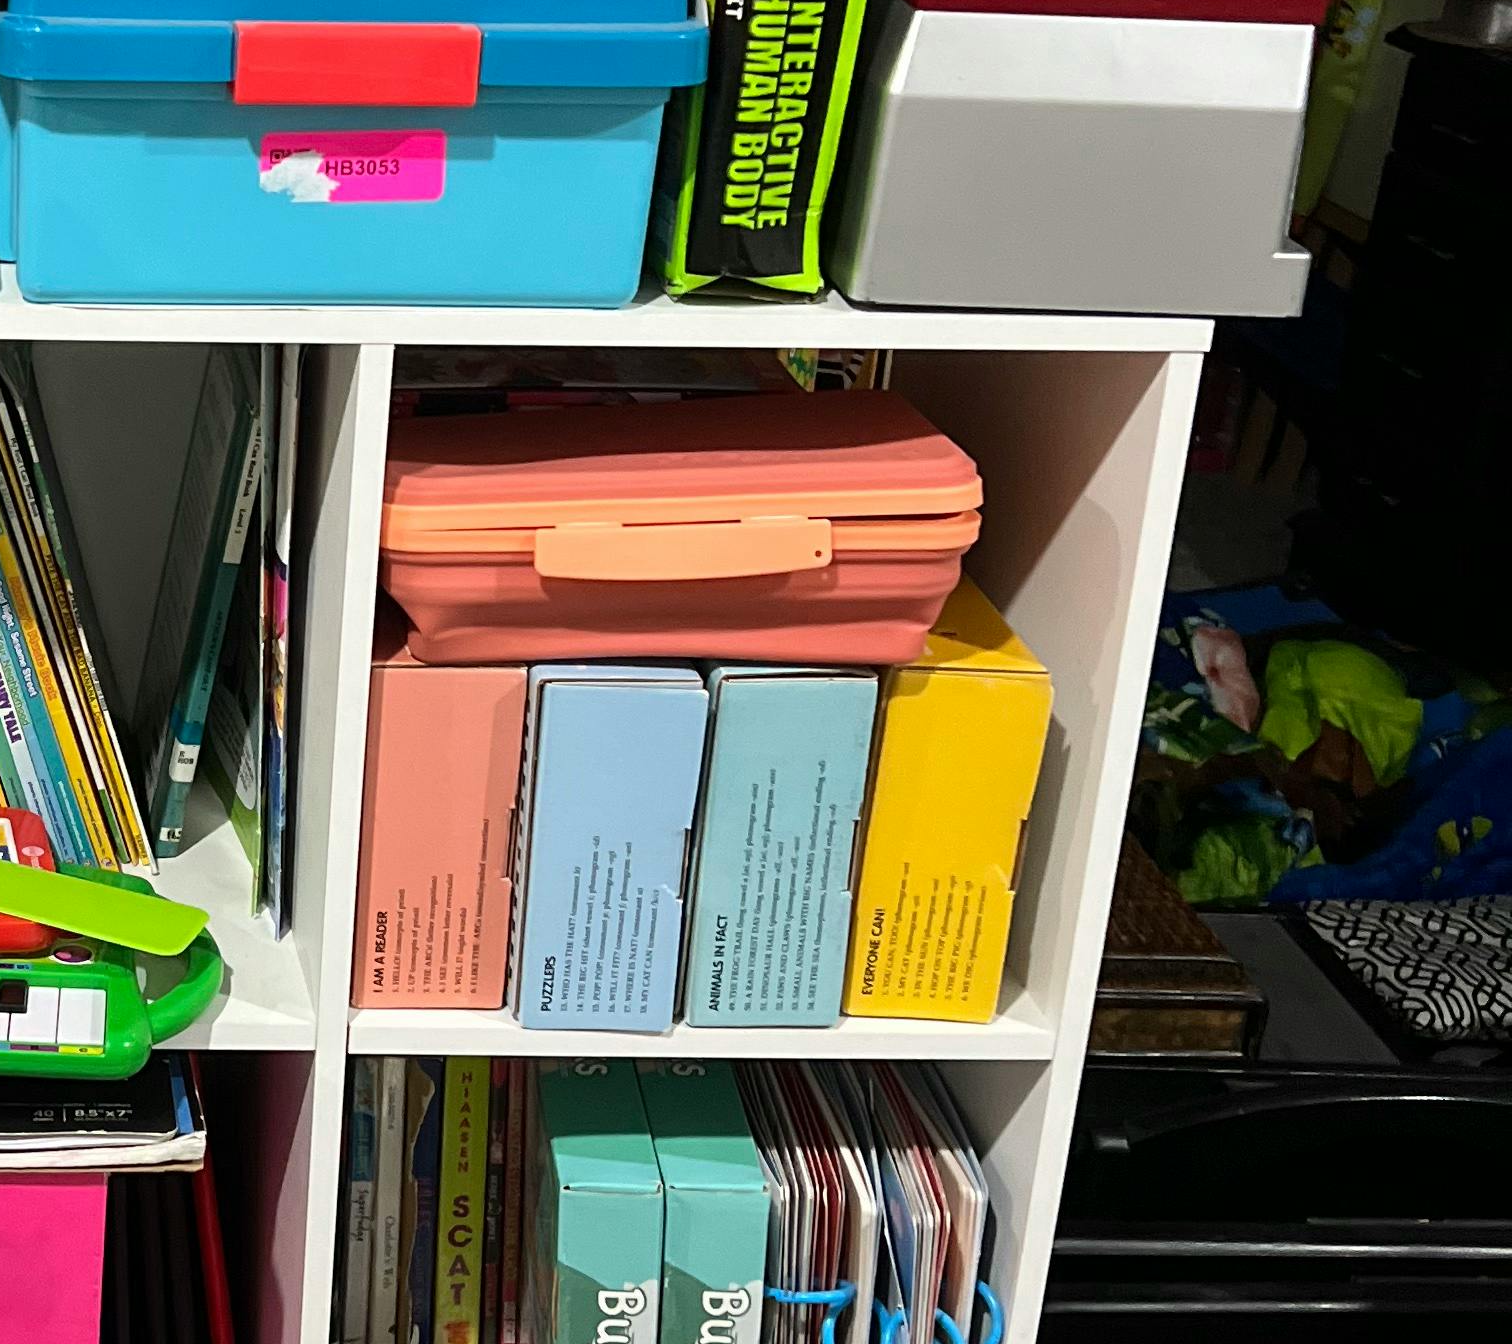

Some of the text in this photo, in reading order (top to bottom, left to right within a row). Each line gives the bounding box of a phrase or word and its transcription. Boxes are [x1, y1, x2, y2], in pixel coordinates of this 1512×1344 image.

[720, 132, 769, 230] BODY
[1, 710, 22, 744] TALE
[374, 956, 384, 964] A
[375, 911, 387, 952] READER
[707, 914, 728, 1011] ANIMALS IN FACT
[860, 907, 886, 995] EVERYONE CAN!
[373, 967, 384, 986] AM
[457, 1071, 472, 1173] HIAASEN
[444, 1194, 474, 1306] SCAT
